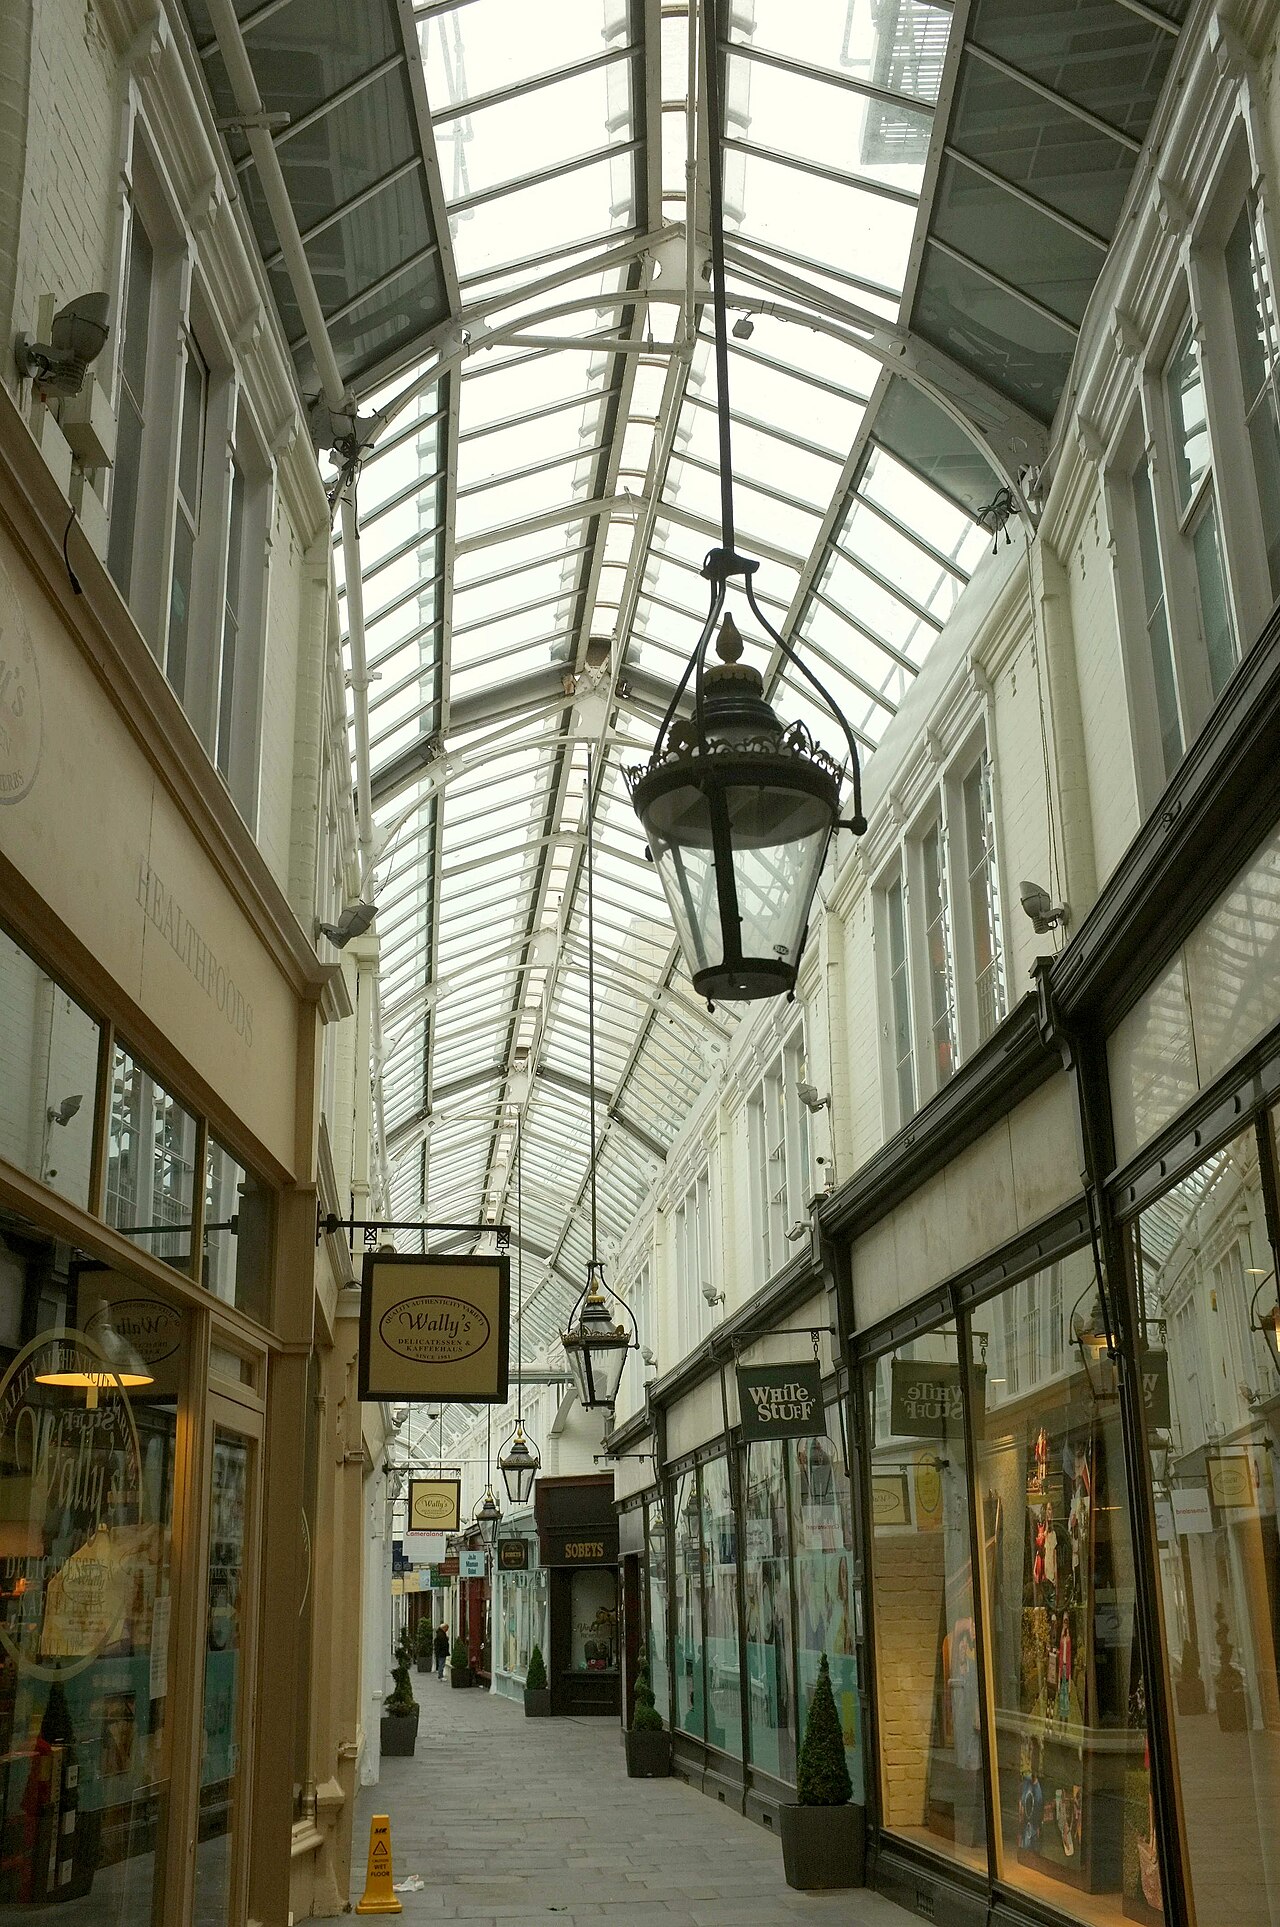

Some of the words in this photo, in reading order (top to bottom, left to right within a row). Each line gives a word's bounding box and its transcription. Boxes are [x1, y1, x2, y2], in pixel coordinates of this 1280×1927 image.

[385, 1303, 410, 1325] QUALITY
[411, 1298, 461, 1308] AUTHENTICITY
[462, 1305, 486, 1326] VARIETY
[398, 1312, 471, 1339] Wally's
[398, 1338, 463, 1346] DELICATESSEN
[406, 1345, 463, 1353] KAFFEEHAUS
[15, 1406, 124, 1548] Wally's
[421, 1500, 448, 1510] Wally's
[564, 1542, 604, 1558] SOBEYS
